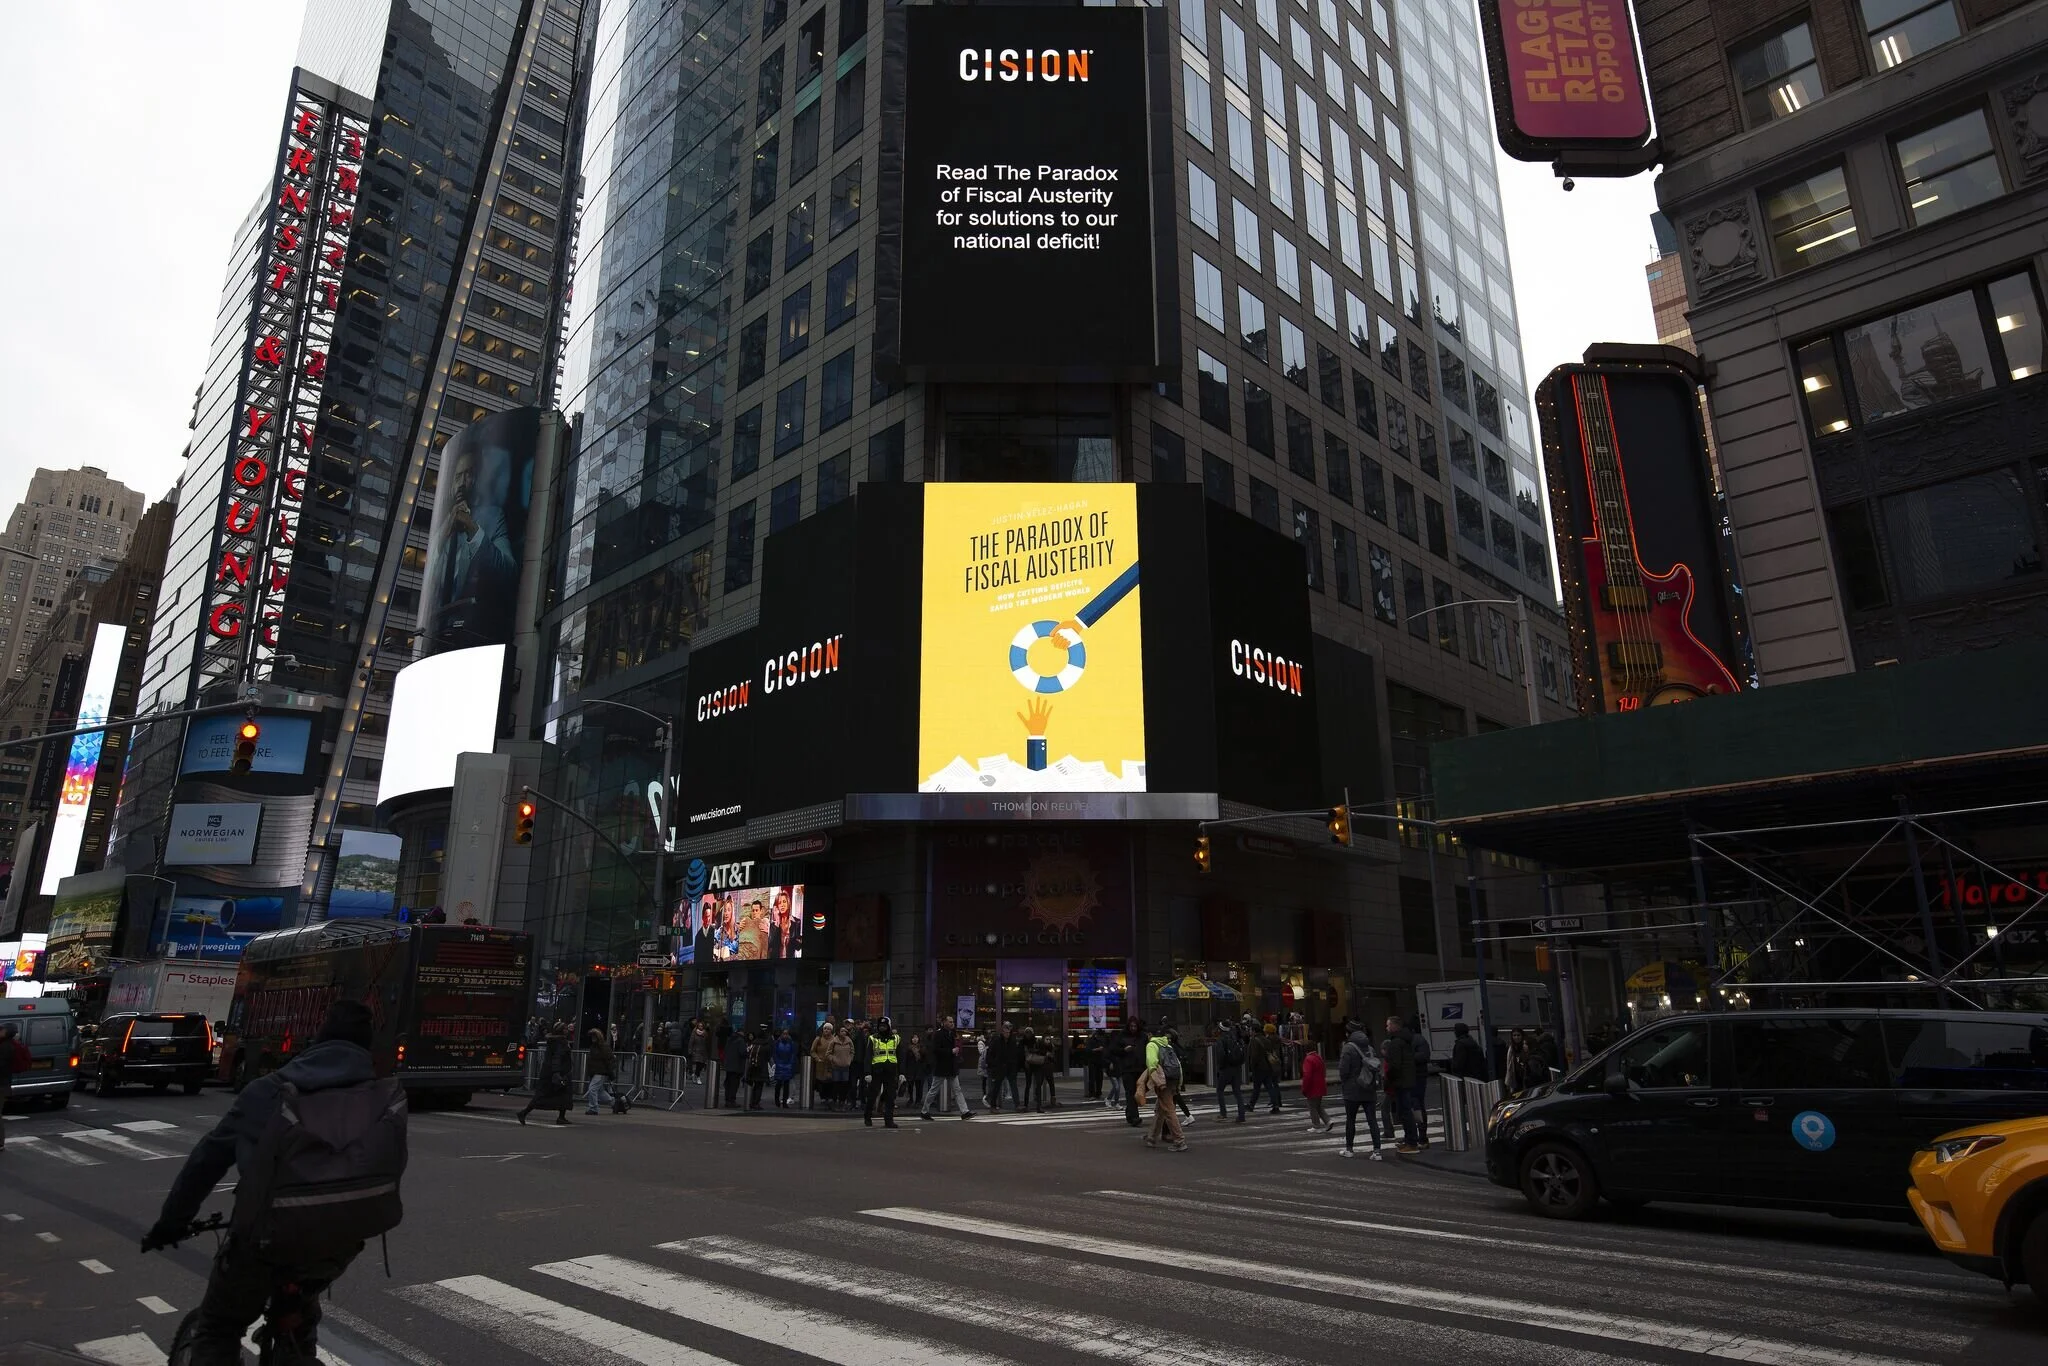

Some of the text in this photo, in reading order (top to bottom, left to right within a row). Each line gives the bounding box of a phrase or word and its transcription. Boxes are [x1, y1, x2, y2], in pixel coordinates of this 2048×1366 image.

[959, 48, 1095, 82] CISION
[936, 164, 1119, 182] Read The Paradox
[941, 187, 1114, 208] of Fiscal Austerity
[936, 209, 1119, 227] for solutions to our
[953, 232, 1101, 250] national deficit!
[208, 111, 318, 638] ERNST & YOUNG
[970, 511, 1109, 562] THE PARADOX OF
[965, 539, 1115, 594] FISCAL AUSTERITY
[764, 633, 844, 694] CISION
[1231, 639, 1303, 697] CISION
[697, 679, 752, 722] CISION
[210, 734, 230, 744] FEEL
[211, 747, 231, 757] FEEL
[690, 804, 742, 824] www.cision.com
[992, 802, 1047, 811] THOMSON
[180, 829, 245, 837] NORWEGIAN
[708, 861, 755, 891] AT&T
[188, 973, 235, 986] Staples
